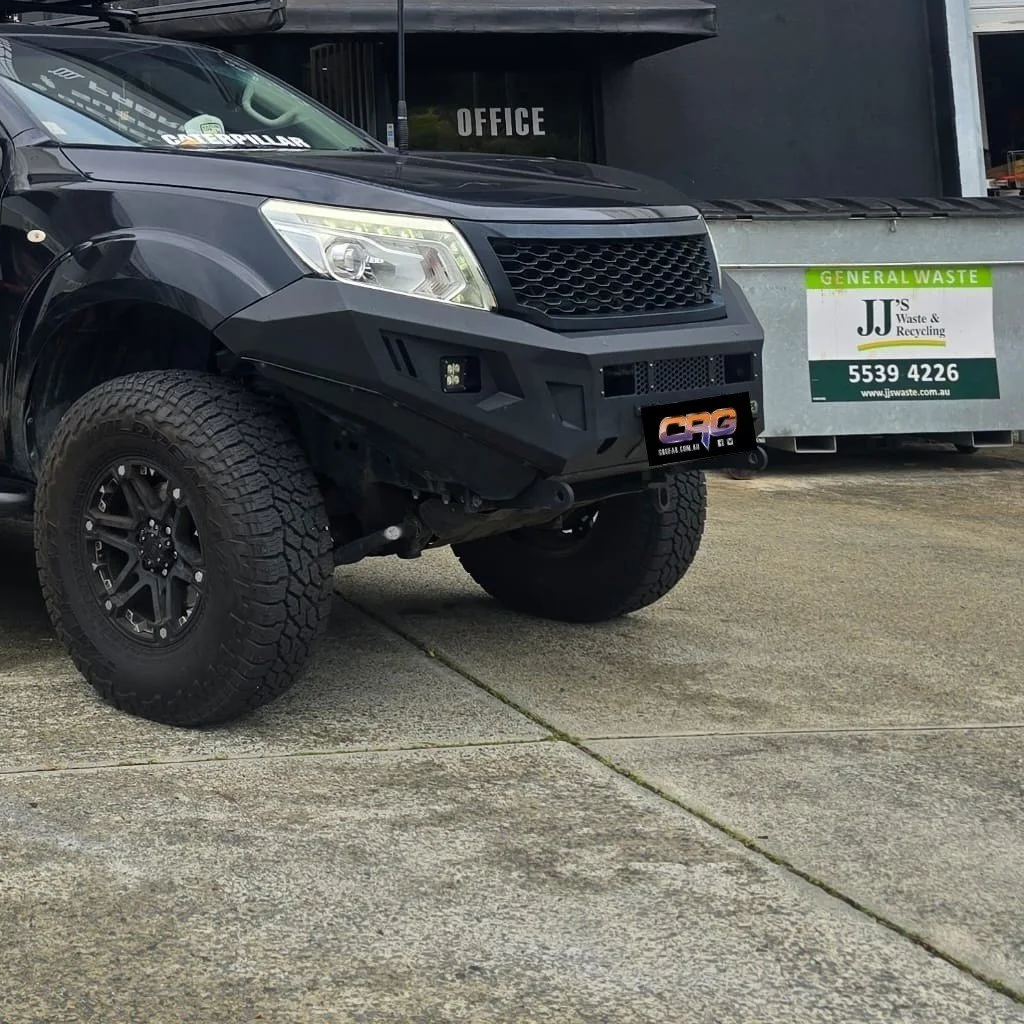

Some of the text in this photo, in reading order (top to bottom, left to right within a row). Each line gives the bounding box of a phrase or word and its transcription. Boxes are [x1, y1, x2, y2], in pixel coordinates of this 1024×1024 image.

[456, 106, 546, 137] OFFICE
[820, 269, 979, 286] GENERAL WASTE
[895, 313, 940, 324] Waste &
[895, 325, 946, 339] Recycling
[848, 362, 960, 383] 5539 4226
[860, 387, 951, 399] www.jjswaste.com.au
